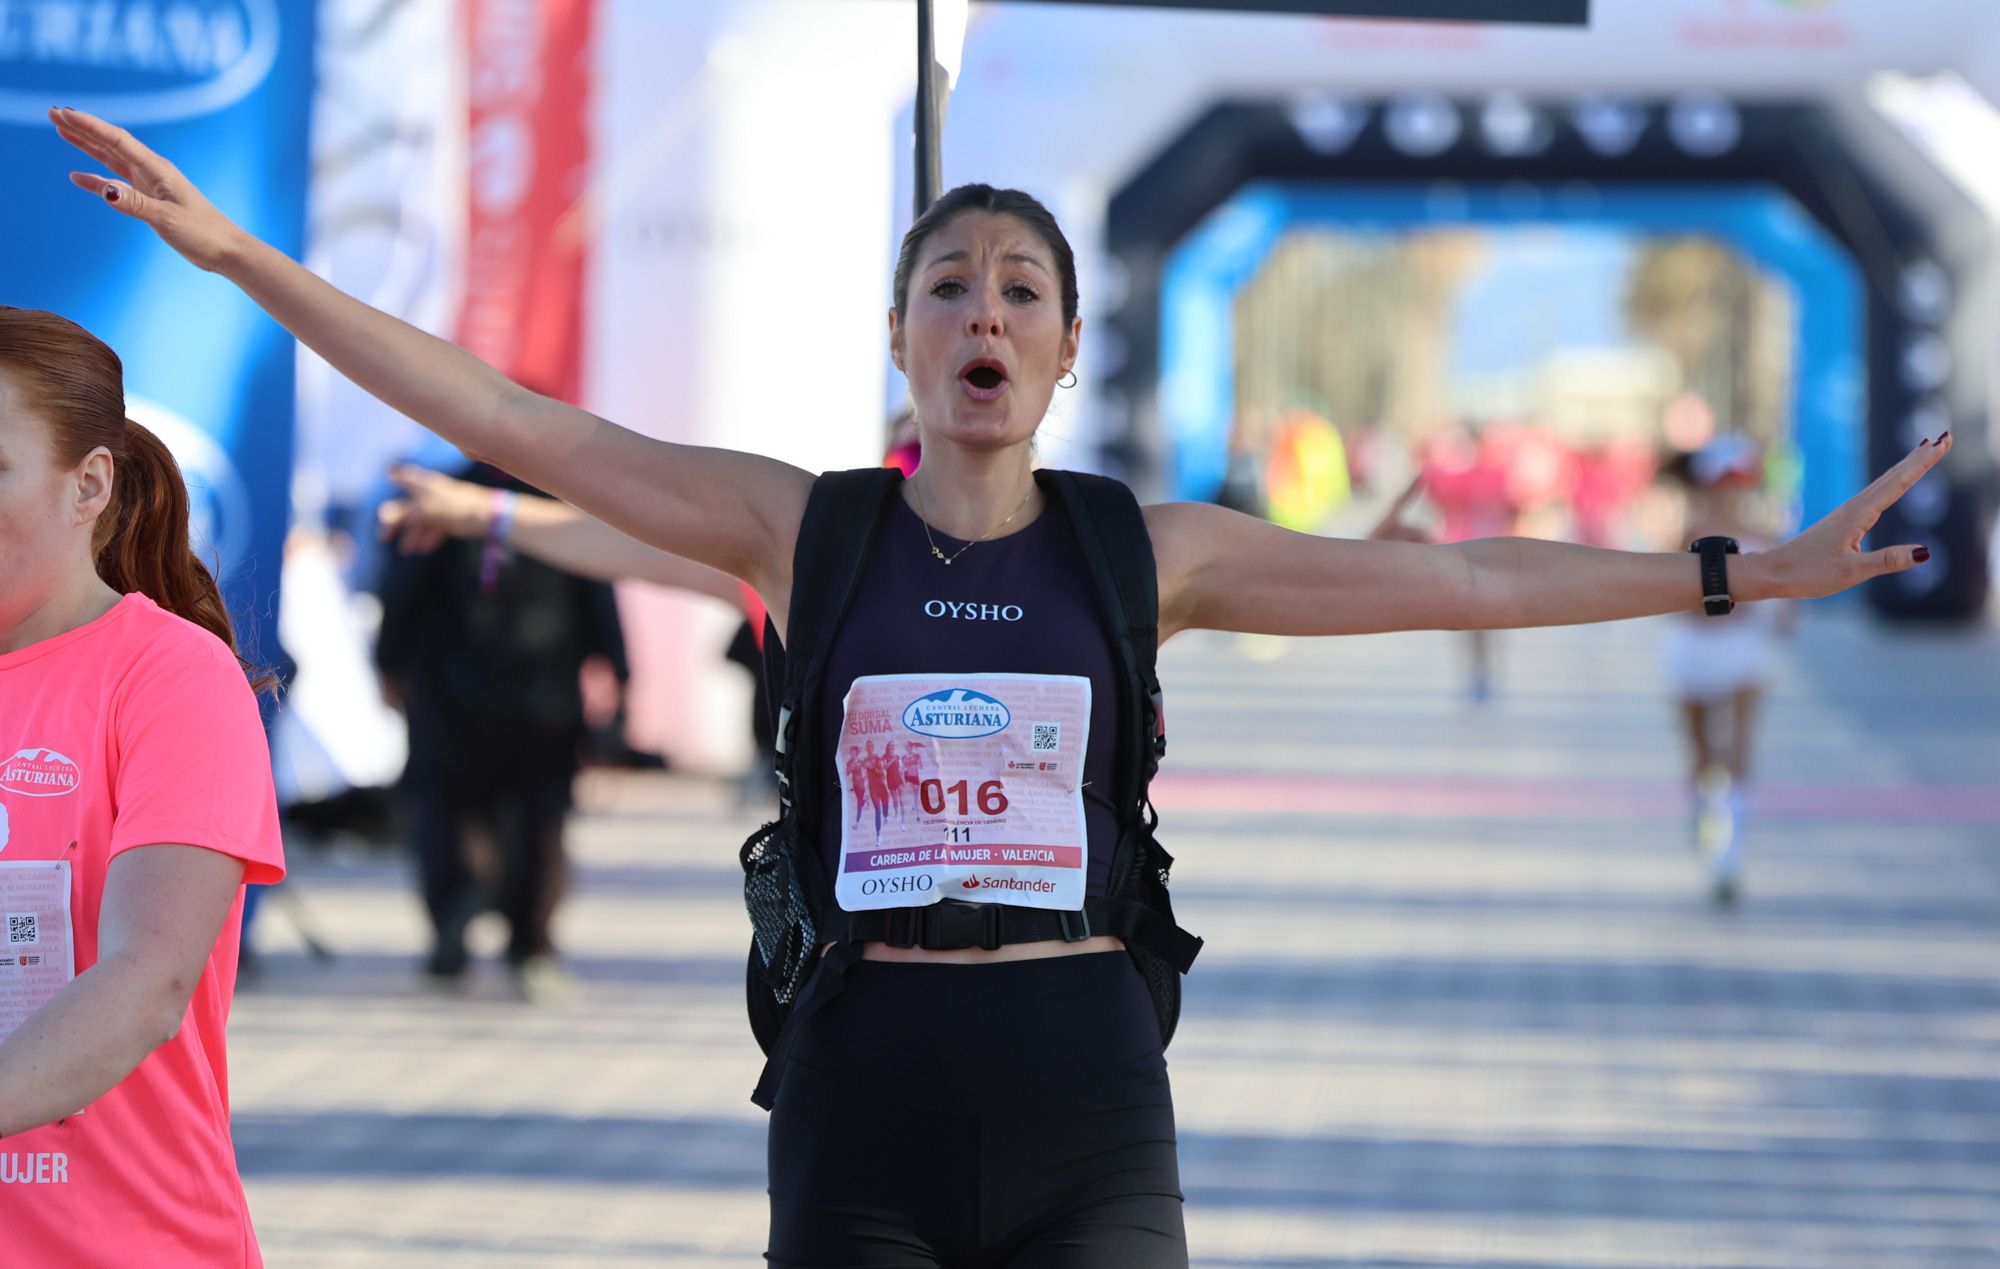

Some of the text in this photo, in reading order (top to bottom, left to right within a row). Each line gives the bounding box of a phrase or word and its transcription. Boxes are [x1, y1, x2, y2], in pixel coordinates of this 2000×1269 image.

[923, 600, 1024, 622] OYSHO
[858, 709, 892, 720] DORSAL
[911, 706, 1002, 727] ASTURIANA
[849, 719, 894, 735] SUMA
[0, 763, 75, 787] ASTURIANA
[919, 778, 1009, 817] 016
[943, 827, 970, 843] 111
[870, 849, 1055, 867] CARRERA DE LA MUJER VALENCIA
[861, 874, 1057, 896] OYSHO Santander
[0, 1151, 69, 1184] UJER
